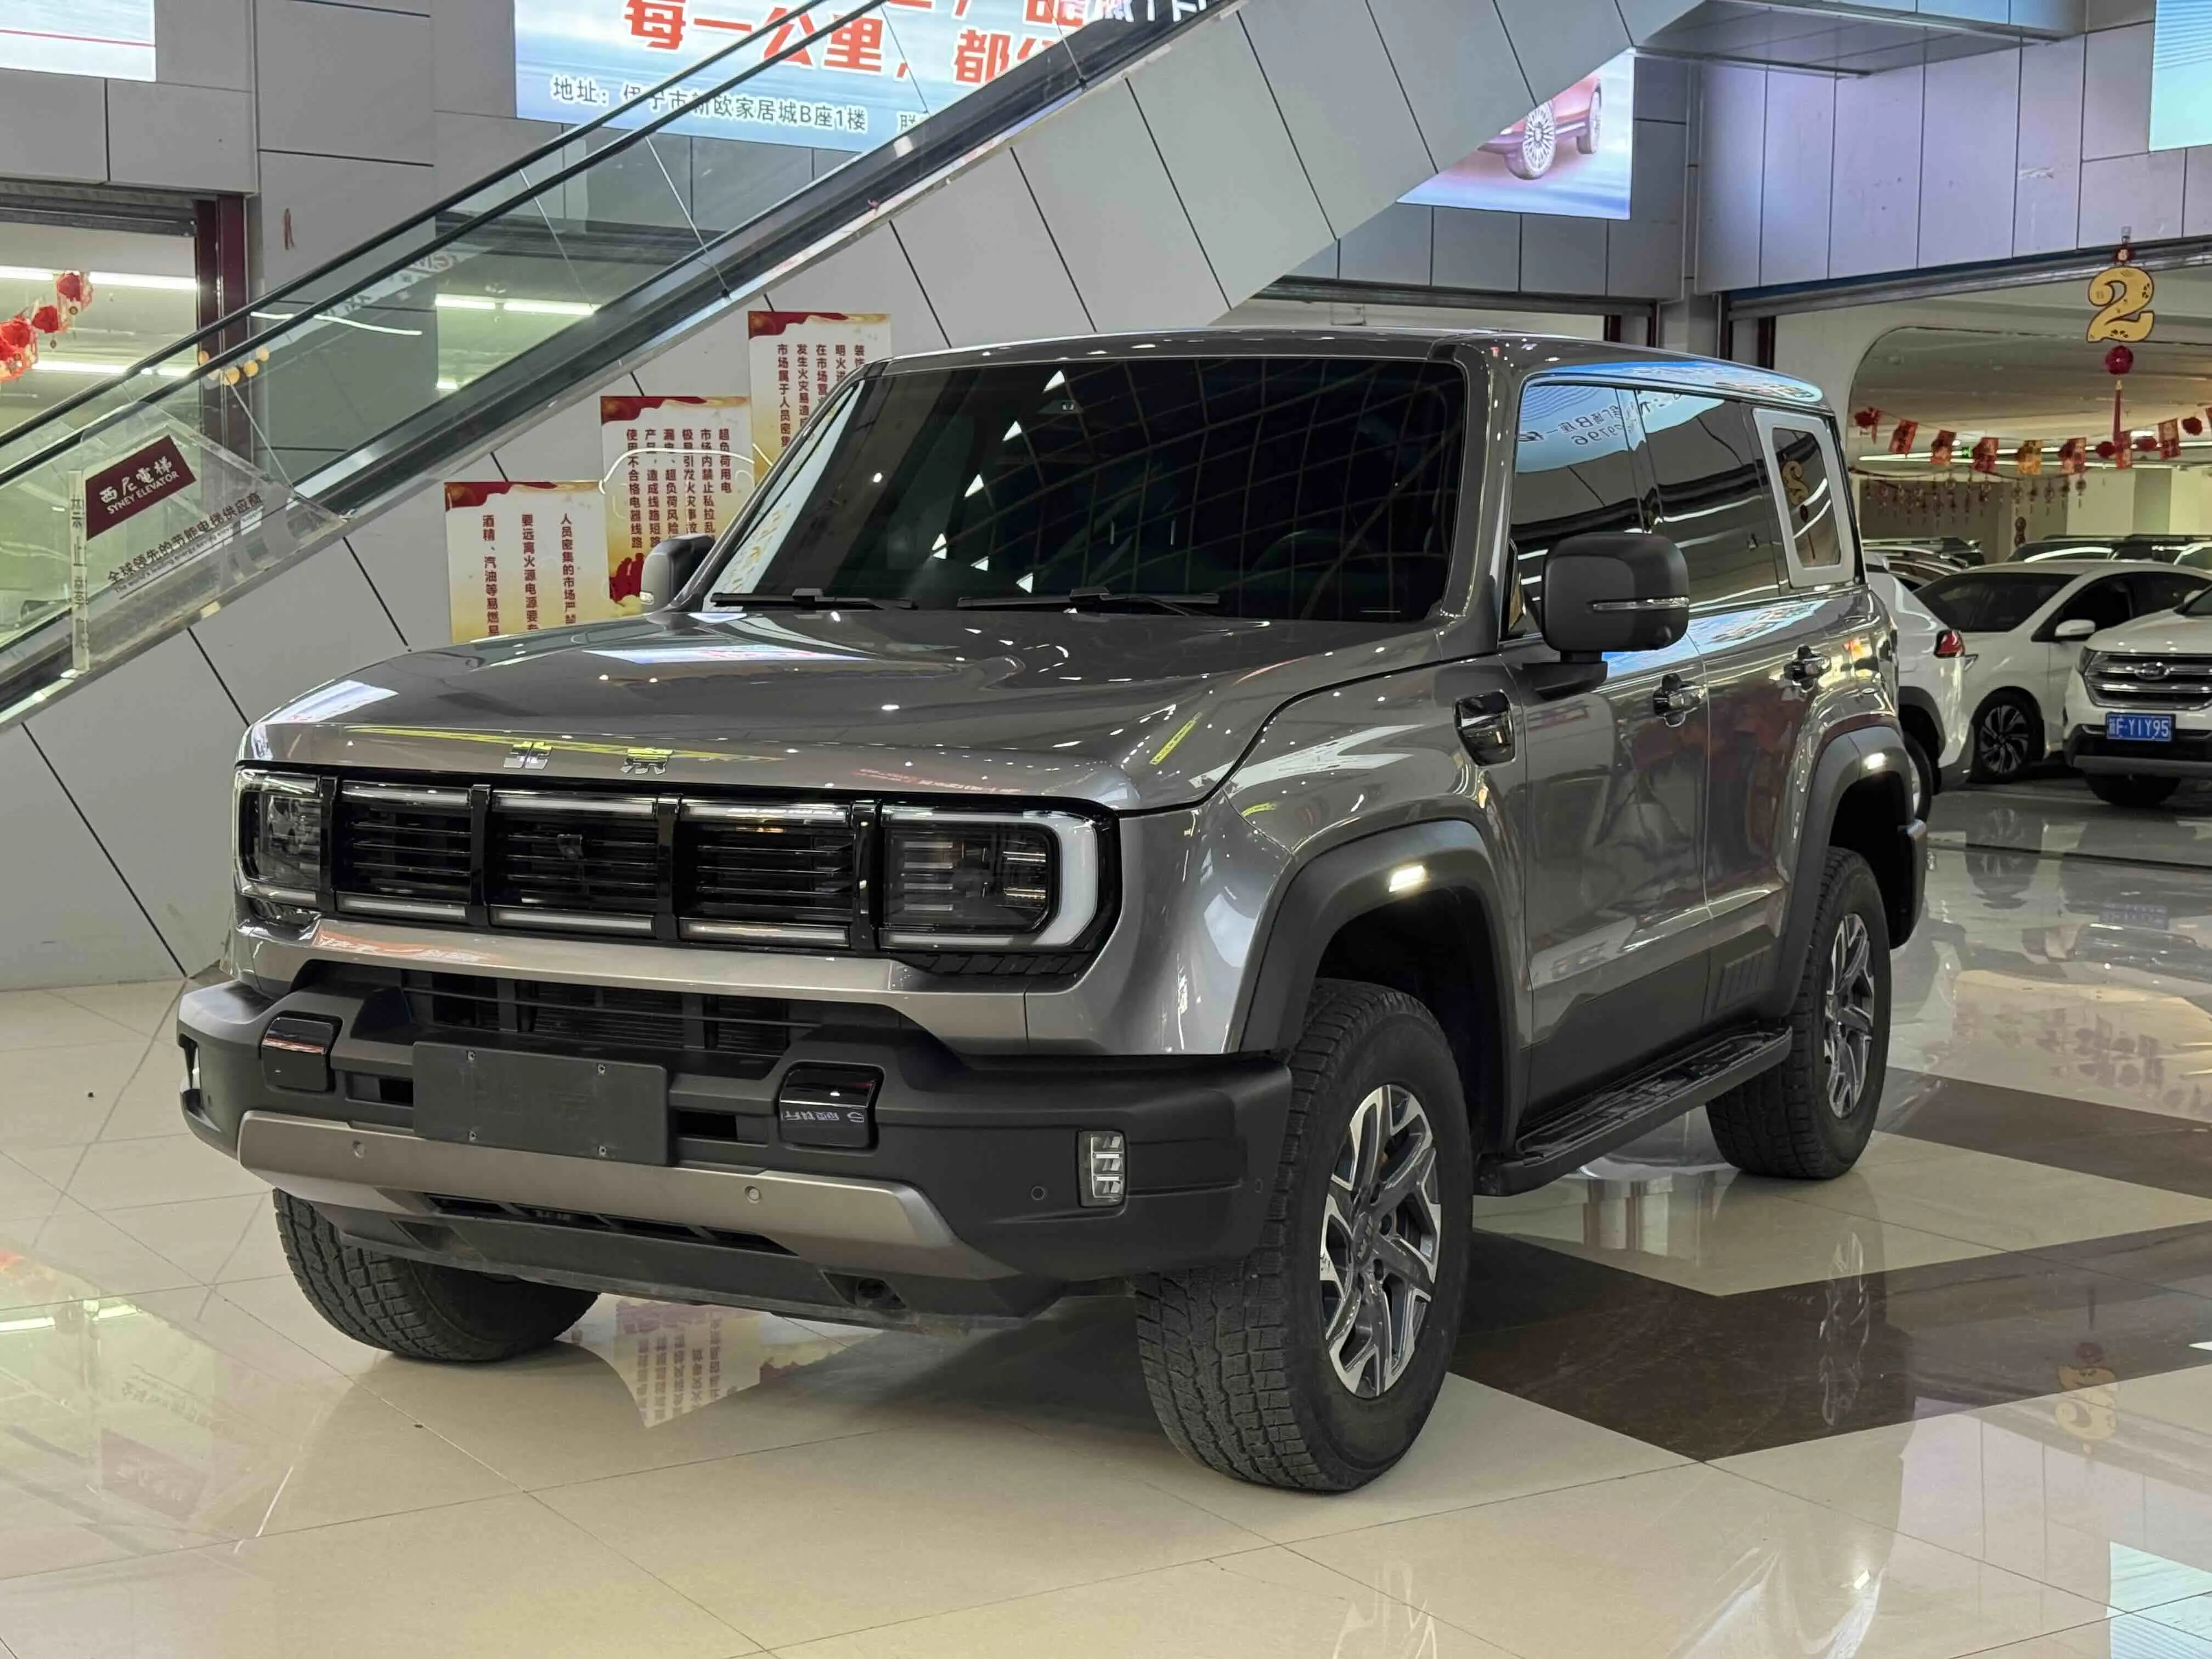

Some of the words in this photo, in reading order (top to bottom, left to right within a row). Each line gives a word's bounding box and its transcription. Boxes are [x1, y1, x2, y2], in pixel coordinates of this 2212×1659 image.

[624, 0, 1054, 83] 每一公里，都
[2087, 266, 2154, 343] 2
[107, 494, 136, 514] SYNEY
[136, 471, 180, 499] ELEVATOR
[664, 429, 679, 538] 漏电、超负荷风险
[701, 429, 715, 537] 市场内禁止私拉乱
[719, 428, 732, 493] 超负荷用电
